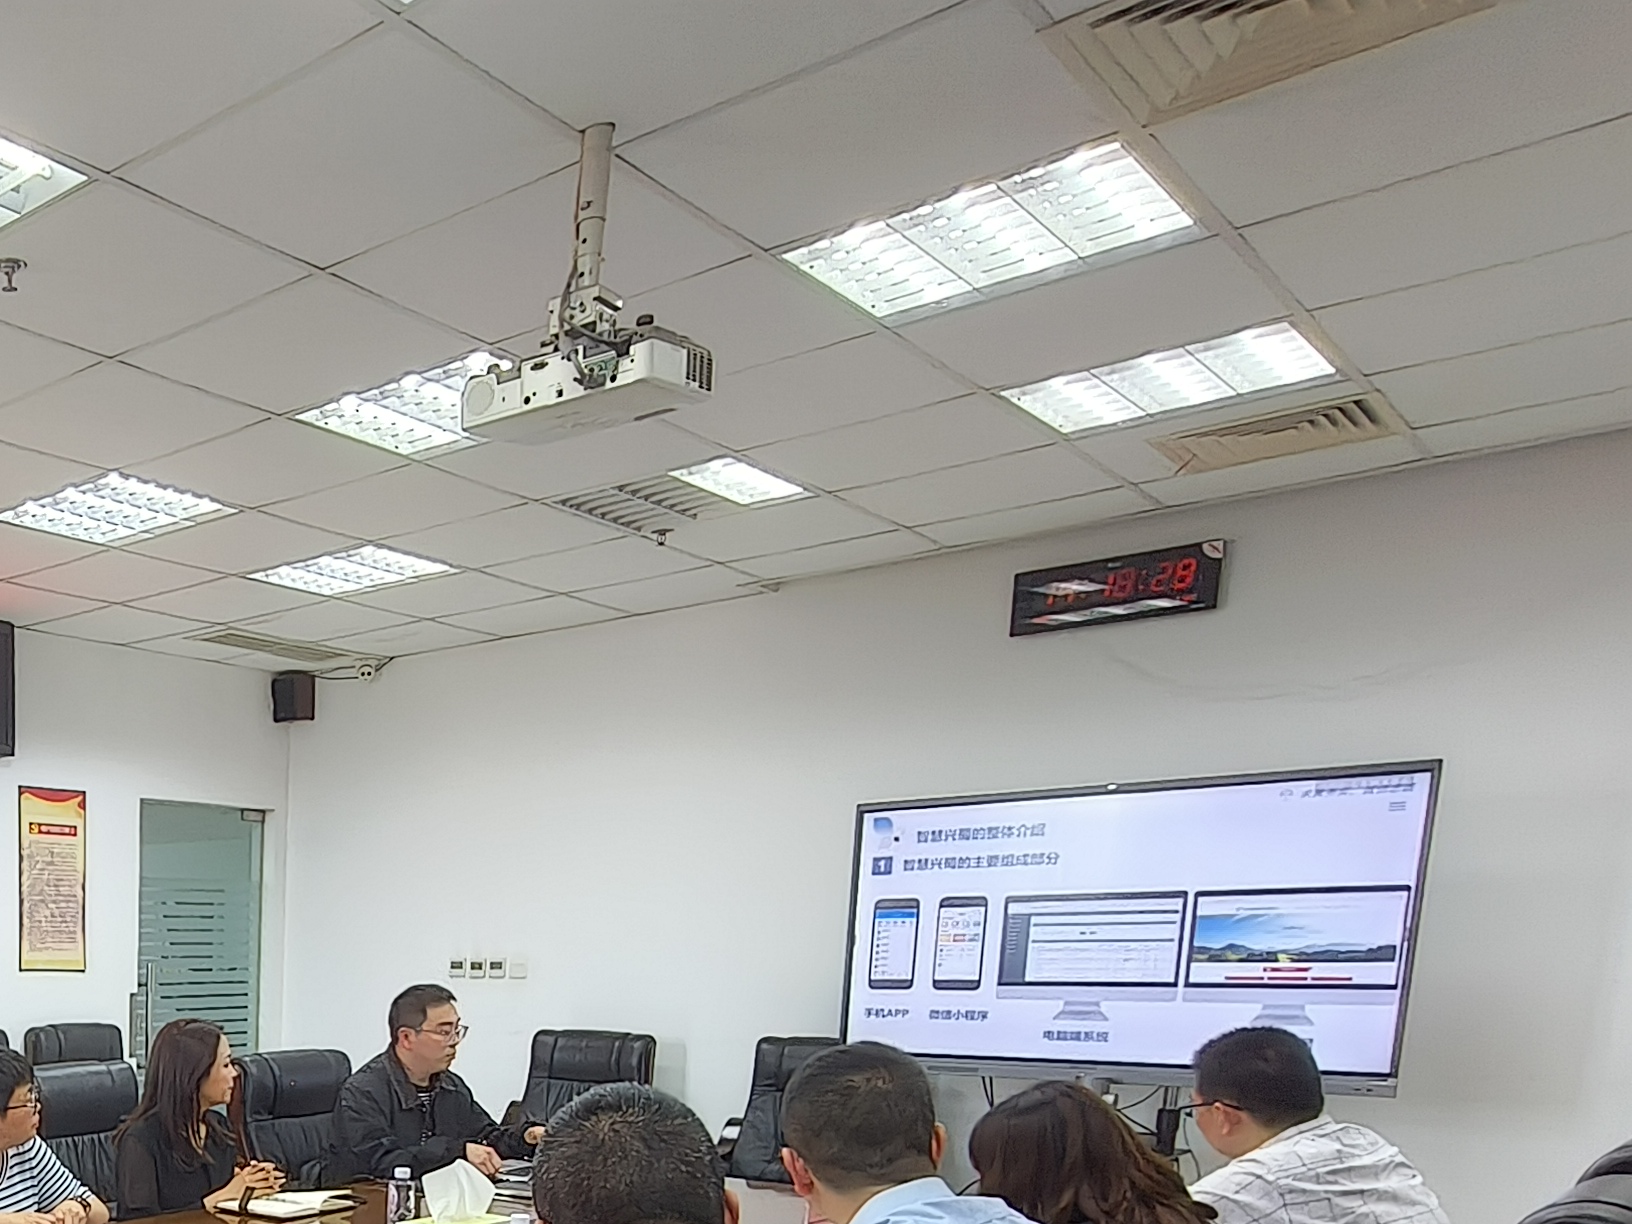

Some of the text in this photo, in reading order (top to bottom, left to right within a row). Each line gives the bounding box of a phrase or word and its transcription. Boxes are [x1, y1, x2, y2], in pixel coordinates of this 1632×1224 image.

[864, 1007, 910, 1020] 手机APP
[928, 1008, 989, 1022] 微信小程序
[1042, 1030, 1110, 1043] 电脑端系统
